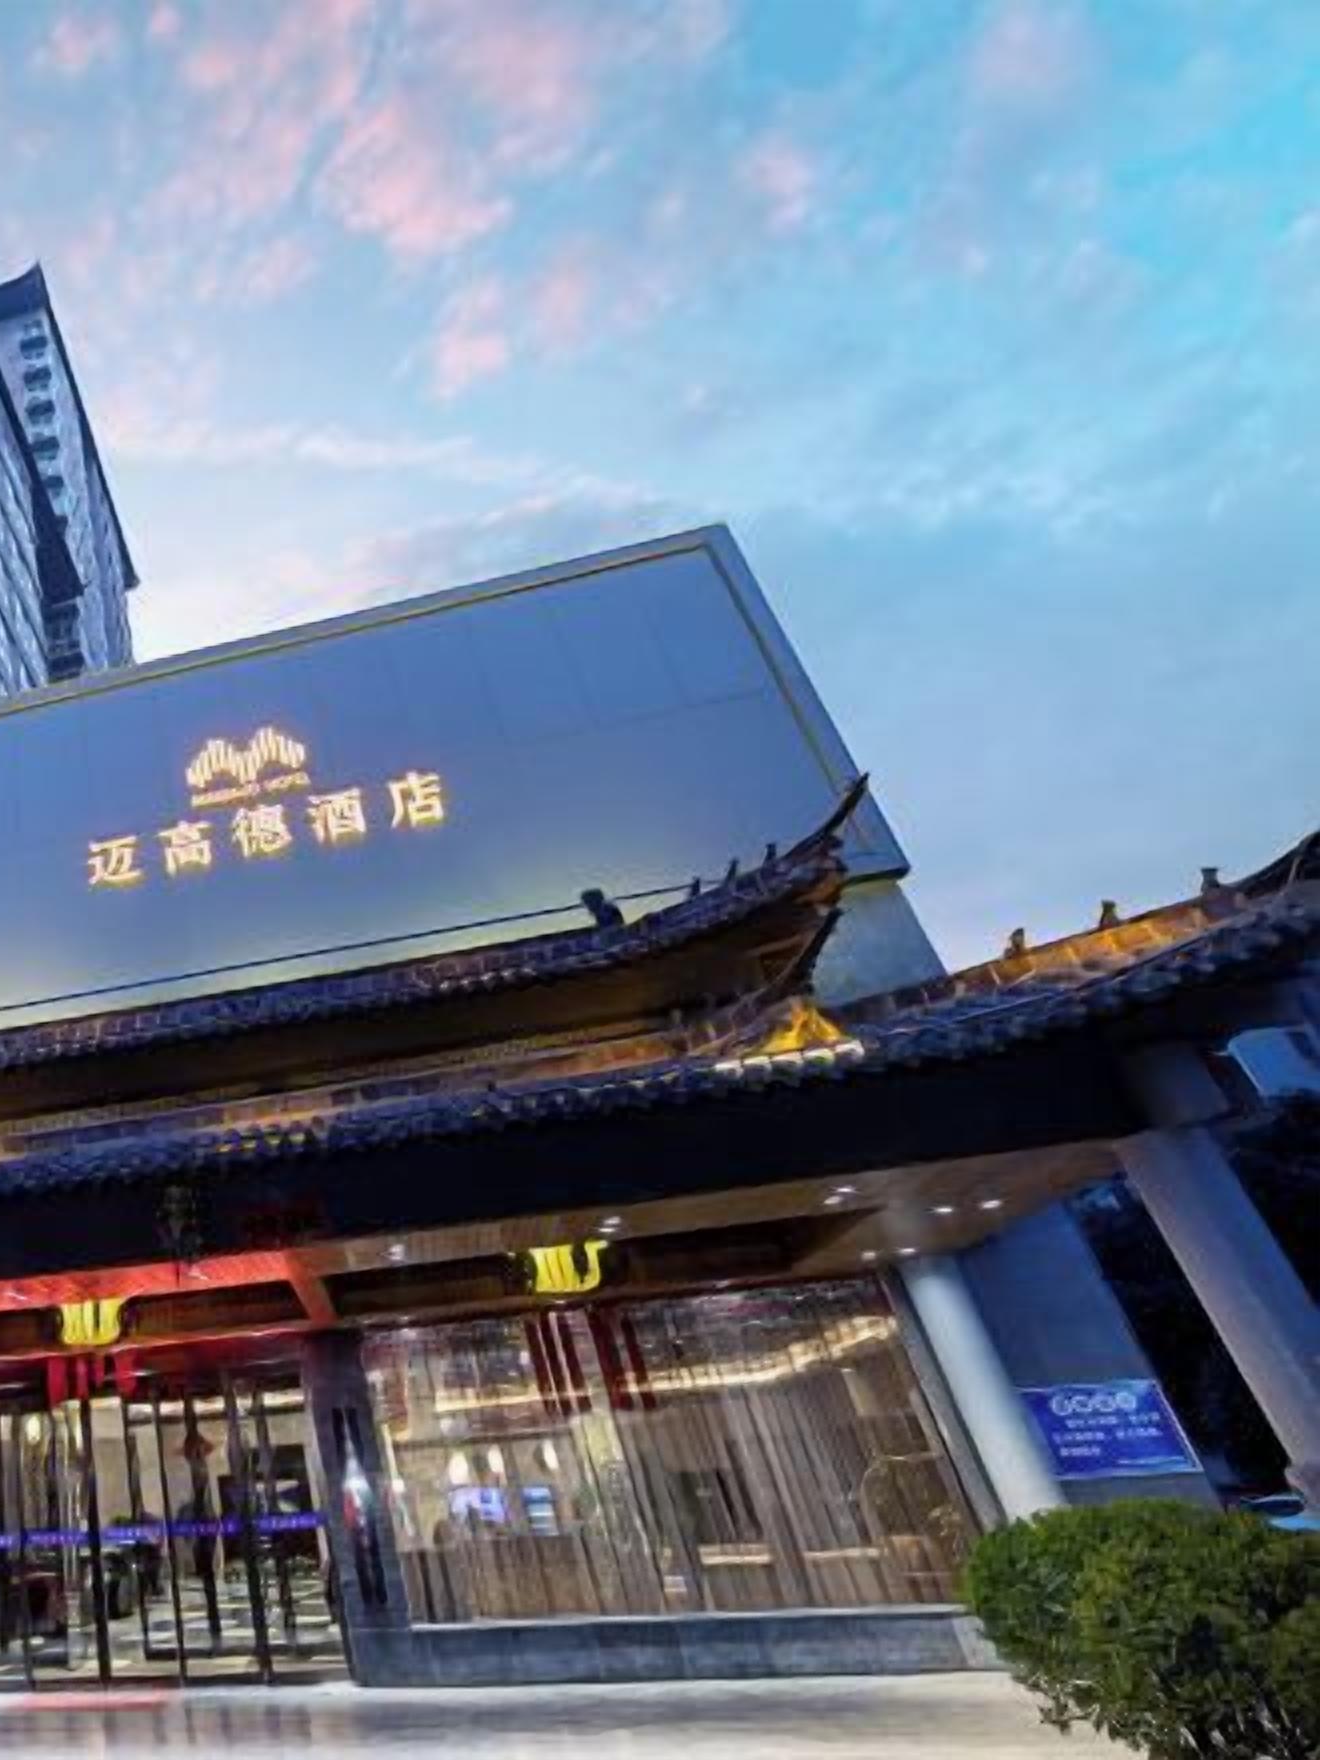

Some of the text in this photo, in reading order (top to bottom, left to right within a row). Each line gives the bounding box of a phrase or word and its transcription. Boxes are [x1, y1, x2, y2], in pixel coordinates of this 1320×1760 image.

[87, 771, 446, 887] 迈高德酒店
